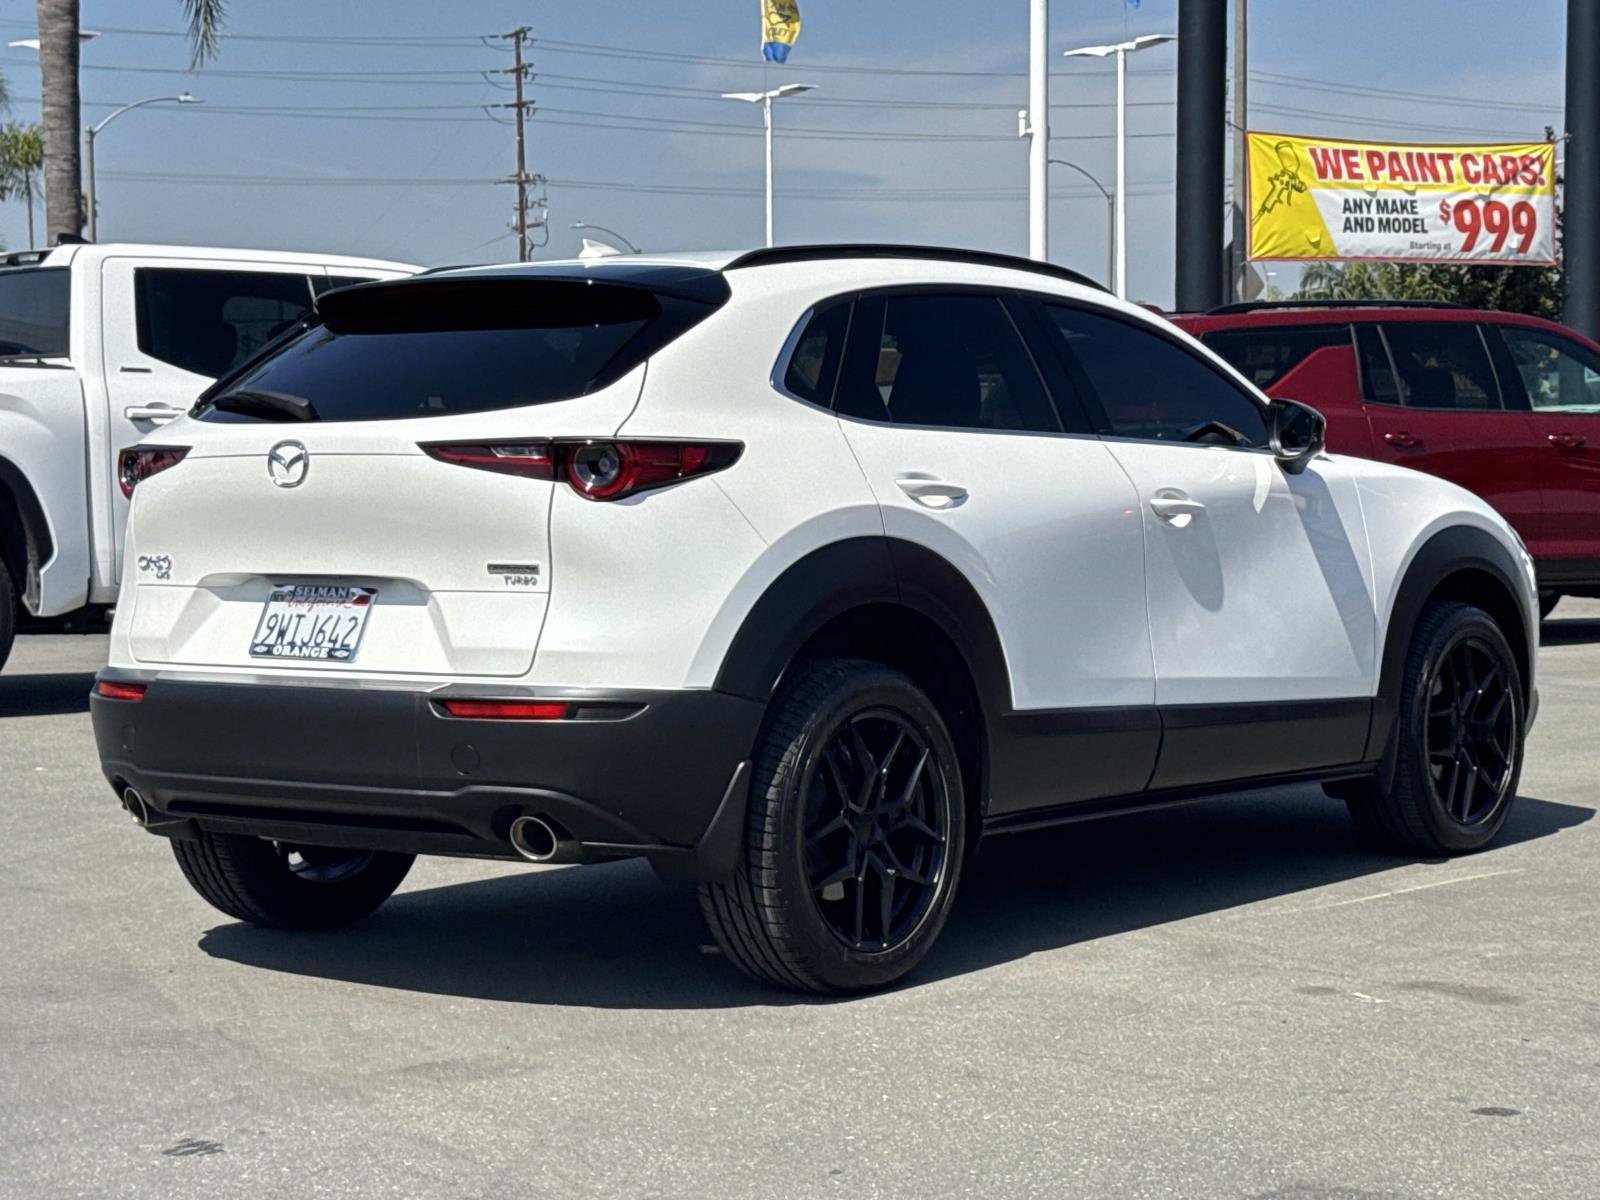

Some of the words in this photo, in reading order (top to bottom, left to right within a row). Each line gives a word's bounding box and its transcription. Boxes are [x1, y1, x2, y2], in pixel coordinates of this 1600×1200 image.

[1309, 147, 1364, 180] WE
[1365, 150, 1454, 183] PAINT
[1459, 152, 1546, 186] CARS!
[1342, 198, 1372, 215] ANY
[1376, 199, 1419, 215] MAKE
[1342, 216, 1375, 233] AND
[1377, 217, 1429, 234] MODEL
[1439, 198, 1537, 254] $999
[1409, 240, 1442, 251] Starting
[1443, 241, 1451, 250] at
[503, 575, 538, 586] TURBO
[272, 645, 329, 659] ORANGE
